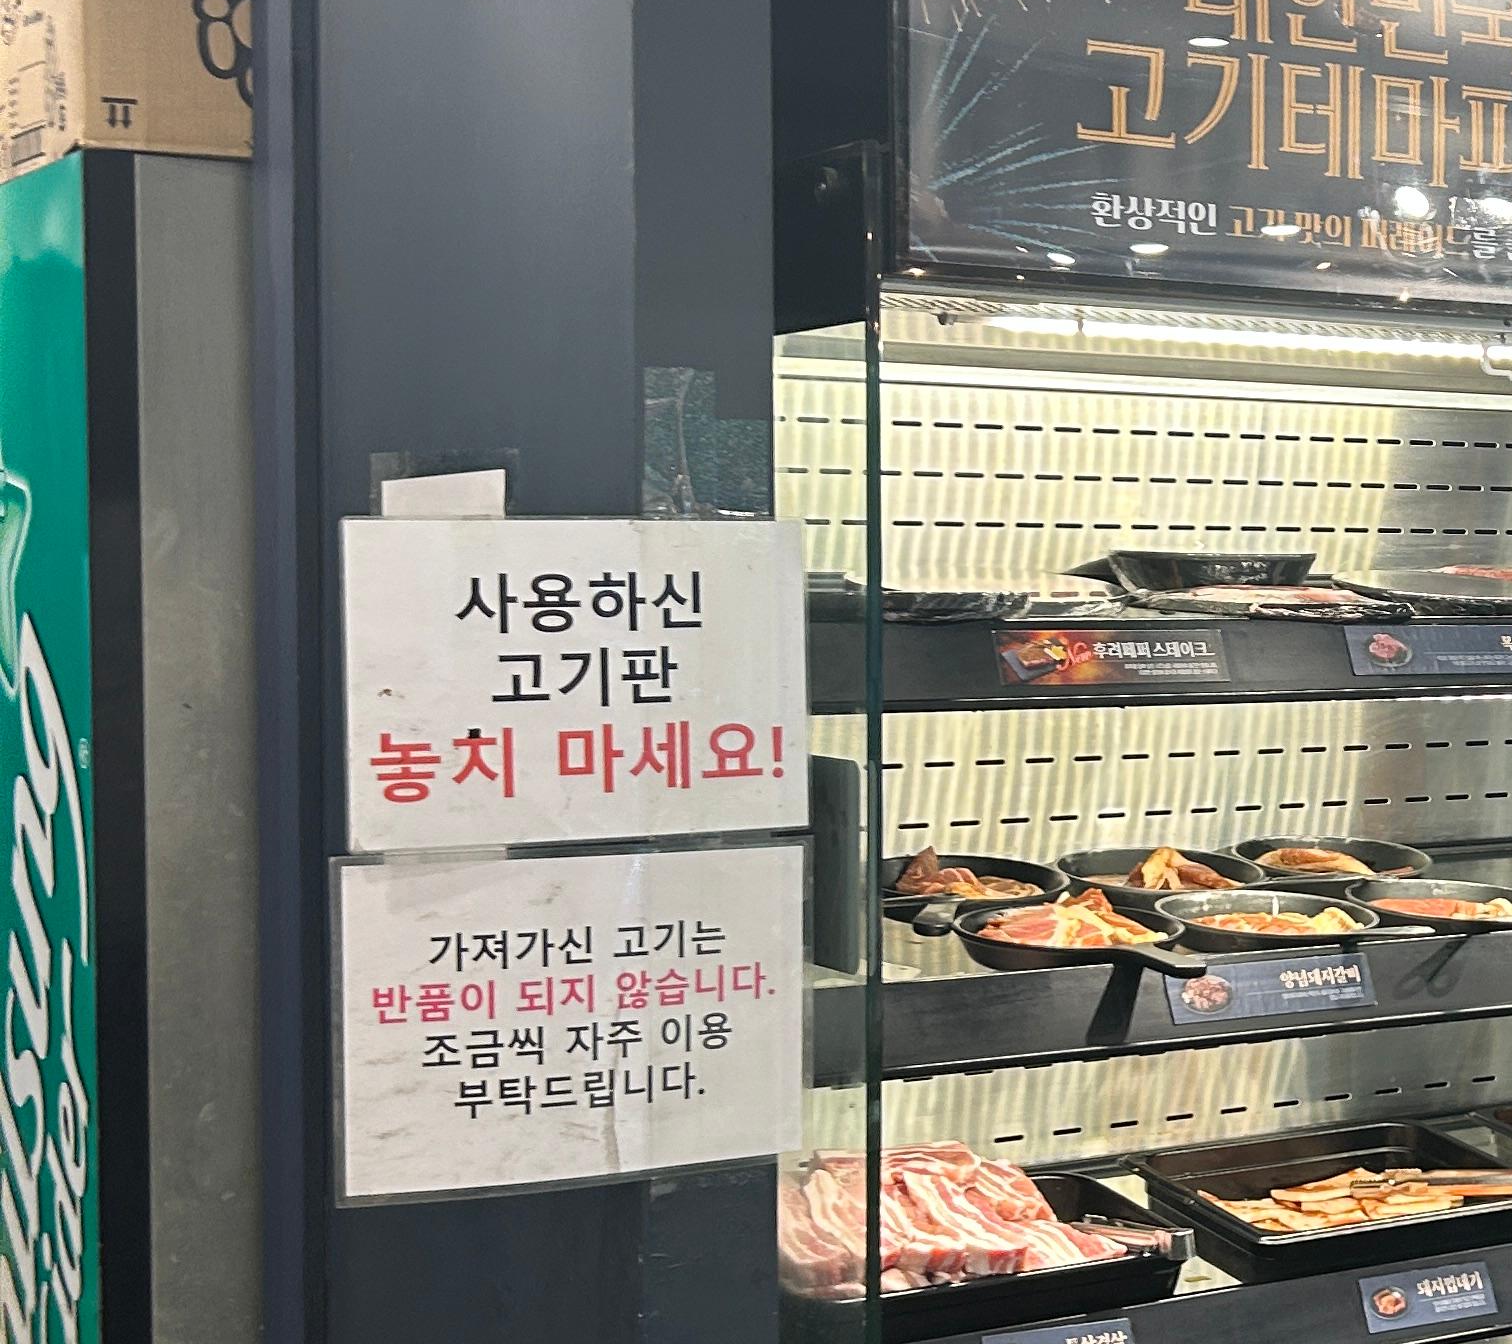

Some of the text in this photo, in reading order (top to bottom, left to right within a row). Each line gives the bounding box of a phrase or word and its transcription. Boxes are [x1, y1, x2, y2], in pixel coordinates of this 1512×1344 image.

[1090, 191, 1217, 236] 환상적인
[1295, 210, 1351, 248] 맛의
[456, 570, 703, 634] 사용하신
[491, 645, 678, 707] 고기판
[1153, 641, 1217, 658] 스테이크
[557, 720, 785, 794] 마세요!
[428, 919, 726, 972] 가져가신 고기는
[371, 960, 777, 1025] 반품이 되지 않습니다.
[421, 1012, 733, 1070] 조금씩 자주 이용
[454, 1061, 706, 1119] 부탁드립니다.
